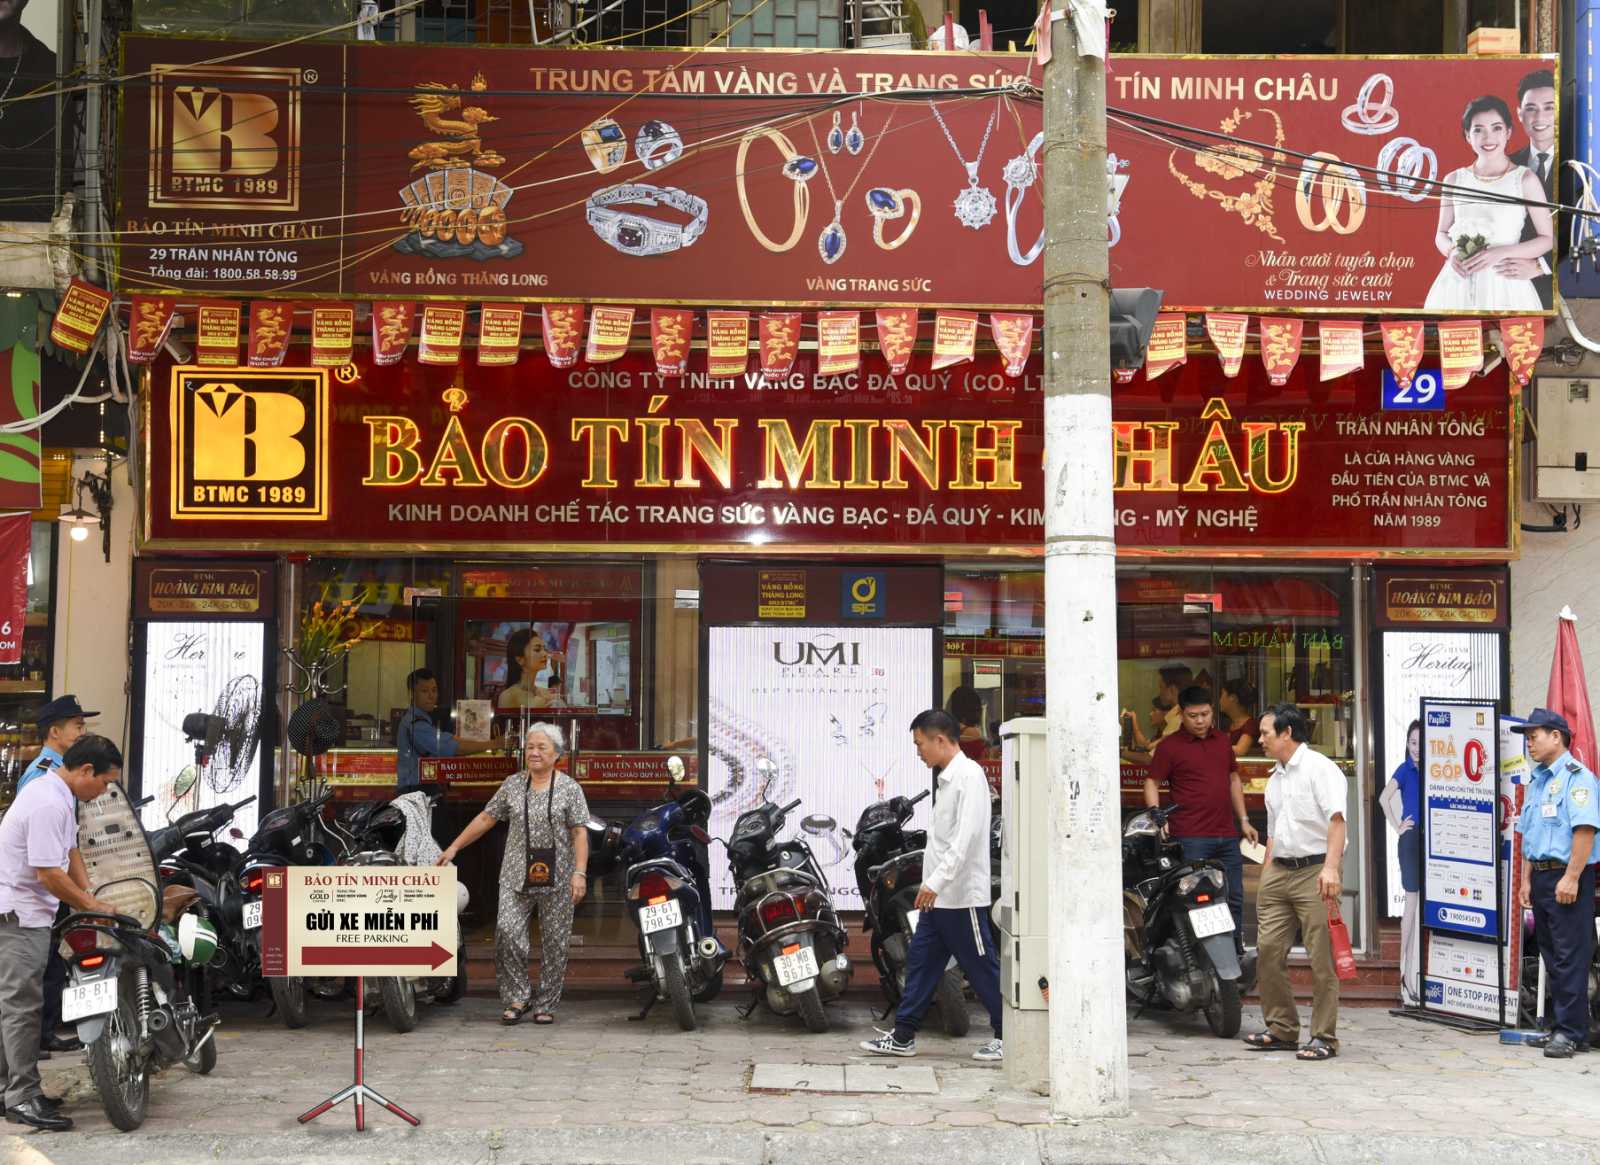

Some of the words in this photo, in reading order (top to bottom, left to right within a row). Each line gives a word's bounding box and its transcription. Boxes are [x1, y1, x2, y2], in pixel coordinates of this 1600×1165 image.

[530, 67, 633, 92] TRUNG
[642, 65, 705, 93] TÂM
[714, 65, 797, 95] VÀNG
[806, 67, 847, 94] VÀ
[1115, 71, 1161, 100] TÍN
[1171, 77, 1244, 100] MINH
[1254, 72, 1339, 101] CHÂU
[172, 177, 224, 193] BTMC
[233, 179, 279, 194] 1989
[211, 223, 263, 238] MINH
[268, 219, 323, 240] CHÂU
[149, 248, 167, 261] 29
[212, 247, 256, 262] NHÂN
[257, 247, 298, 264] TÔNG
[370, 269, 412, 285] VÀNG
[415, 267, 457, 286] RỒNG
[511, 273, 549, 287] LONG
[806, 276, 847, 291] VÀNG
[849, 279, 899, 292] TRANG
[902, 277, 932, 292] SỨC
[1264, 289, 1329, 300] WEDDING
[1335, 290, 1393, 301] JEWELRY
[568, 368, 632, 389] CÔNG
[813, 372, 858, 394] BẠC
[904, 368, 952, 391] QUÝ
[1393, 374, 1437, 403] 29
[1385, 419, 1432, 435] NHÂN
[1438, 419, 1485, 436] TÔNG
[362, 386, 548, 488] BẢO
[571, 394, 738, 489] TÍN
[757, 419, 1022, 490] MINH
[1112, 397, 1305, 493] HÂU
[1345, 451, 1361, 465] LÀ
[1395, 451, 1435, 465] HÀNG
[1438, 452, 1475, 466] VÀNG
[1364, 472, 1394, 486] TIÊN
[1397, 471, 1424, 486] CỦA
[1429, 475, 1469, 487] BTMC
[1474, 473, 1490, 487] VÀ
[194, 486, 248, 502] BTMC
[258, 487, 305, 502] 1989
[1404, 493, 1443, 507] NHÂN
[1447, 493, 1488, 508] TÔNG
[388, 504, 441, 522] KINH
[450, 504, 528, 523] DOANH
[535, 498, 581, 523] CHẾ
[586, 500, 629, 523] TÁC
[636, 505, 714, 524] TRANG
[721, 501, 765, 525] SỨC
[774, 502, 834, 525] VÀNG
[843, 506, 888, 529] BẠC
[906, 504, 937, 525] ĐÁ
[943, 504, 989, 525] QUÝ
[1010, 508, 1046, 527] KIM
[1156, 505, 1190, 527] MỸ
[1197, 506, 1258, 532] NGHỆ
[1374, 513, 1406, 527] NĂM
[1411, 515, 1440, 527] 1989
[774, 641, 861, 666] UMI
[304, 873, 332, 886] BẢO
[336, 873, 358, 886] TÍN
[362, 875, 400, 886] MINH
[402, 872, 440, 886] CHÂU
[306, 909, 334, 931] GỬI
[340, 913, 359, 931] XE
[365, 908, 404, 931] MIỄN
[411, 910, 438, 931] PHÍ
[336, 934, 360, 943] FREE
[364, 934, 409, 943] PARKING
[1448, 986, 1461, 997] ONE
[1463, 989, 1482, 1001] STOP
[1484, 992, 1518, 1008] PAYENT
